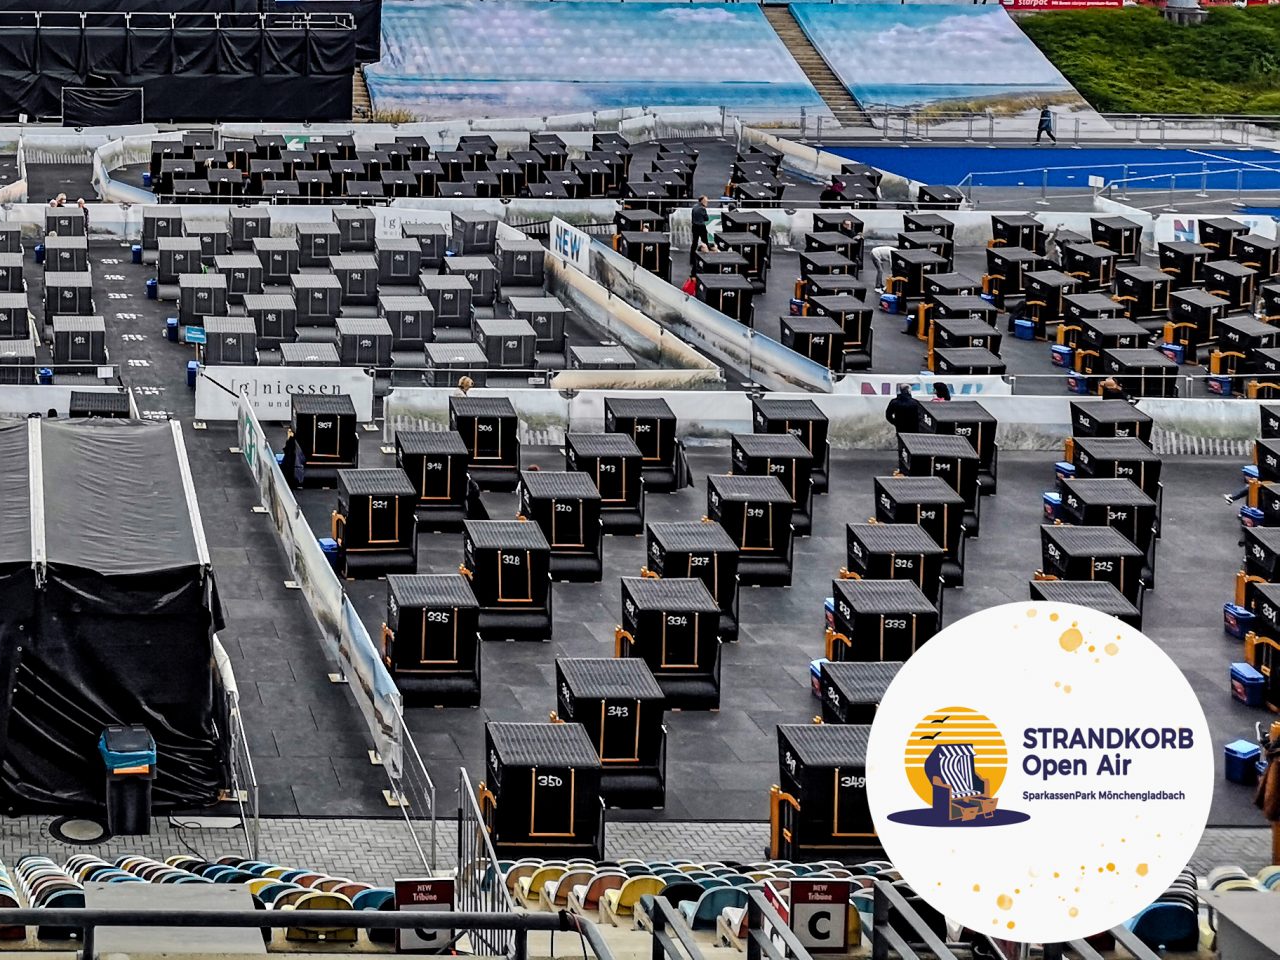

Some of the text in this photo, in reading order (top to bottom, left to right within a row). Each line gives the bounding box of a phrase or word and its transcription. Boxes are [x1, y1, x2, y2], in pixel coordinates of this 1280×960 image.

[318, 421, 332, 429] 307
[478, 424, 493, 432] 306
[955, 427, 972, 436] 303
[427, 463, 443, 471] 314
[600, 464, 616, 473] 313
[770, 464, 785, 473] 312
[935, 463, 951, 471] 311
[1117, 467, 1133, 475] 310
[372, 501, 388, 509] 321
[555, 504, 572, 512] 320
[747, 508, 763, 518] 319
[920, 511, 935, 519] 318
[1109, 511, 1127, 520] 317
[503, 555, 520, 565] 328
[691, 557, 709, 566] 327
[895, 559, 913, 568] 326
[1094, 562, 1113, 572] 325
[427, 611, 449, 623] 335
[667, 616, 687, 626] 334
[885, 619, 906, 628] 333
[607, 706, 629, 717] 343
[538, 776, 563, 787] 350
[841, 776, 866, 788] 349
[413, 893, 437, 901] Tribüne
[808, 911, 832, 940] C
